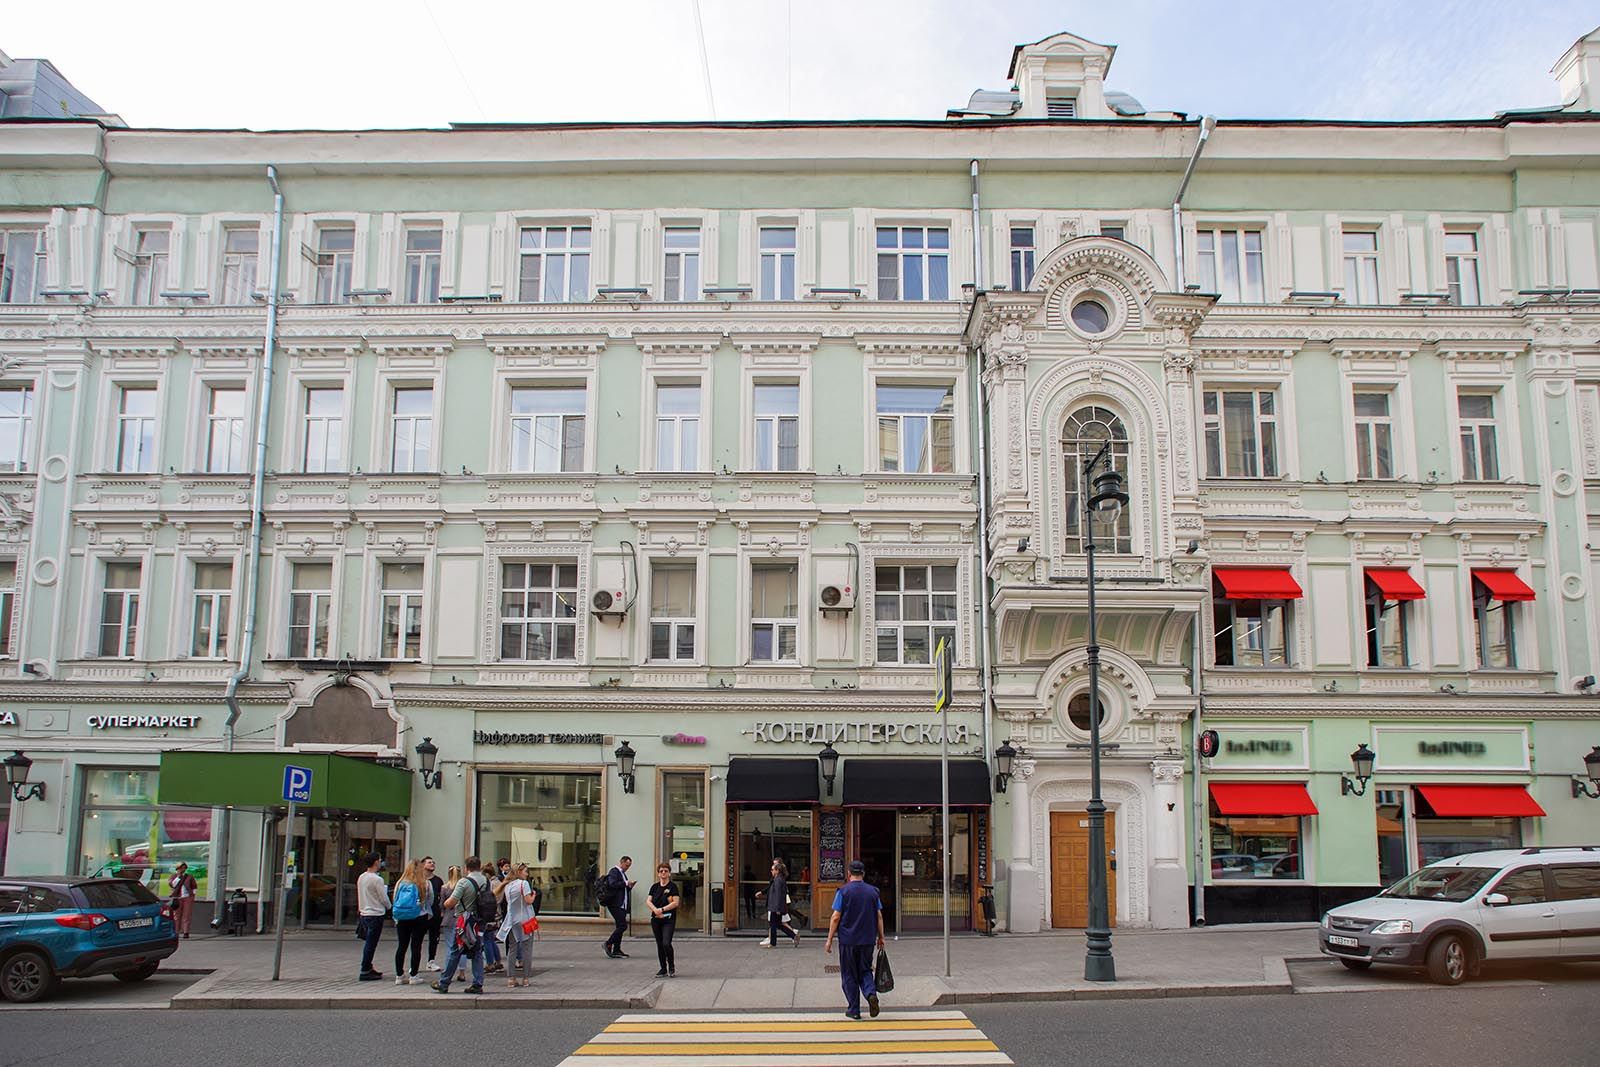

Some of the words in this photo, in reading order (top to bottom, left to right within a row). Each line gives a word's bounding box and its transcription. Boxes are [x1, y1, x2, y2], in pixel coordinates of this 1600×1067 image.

[87, 715, 200, 729] СУПЕРМАРКЕТ
[473, 730, 545, 745] Цифровая
[548, 732, 604, 744] техника
[753, 722, 969, 744] КОНДИТЕРСКАЯ
